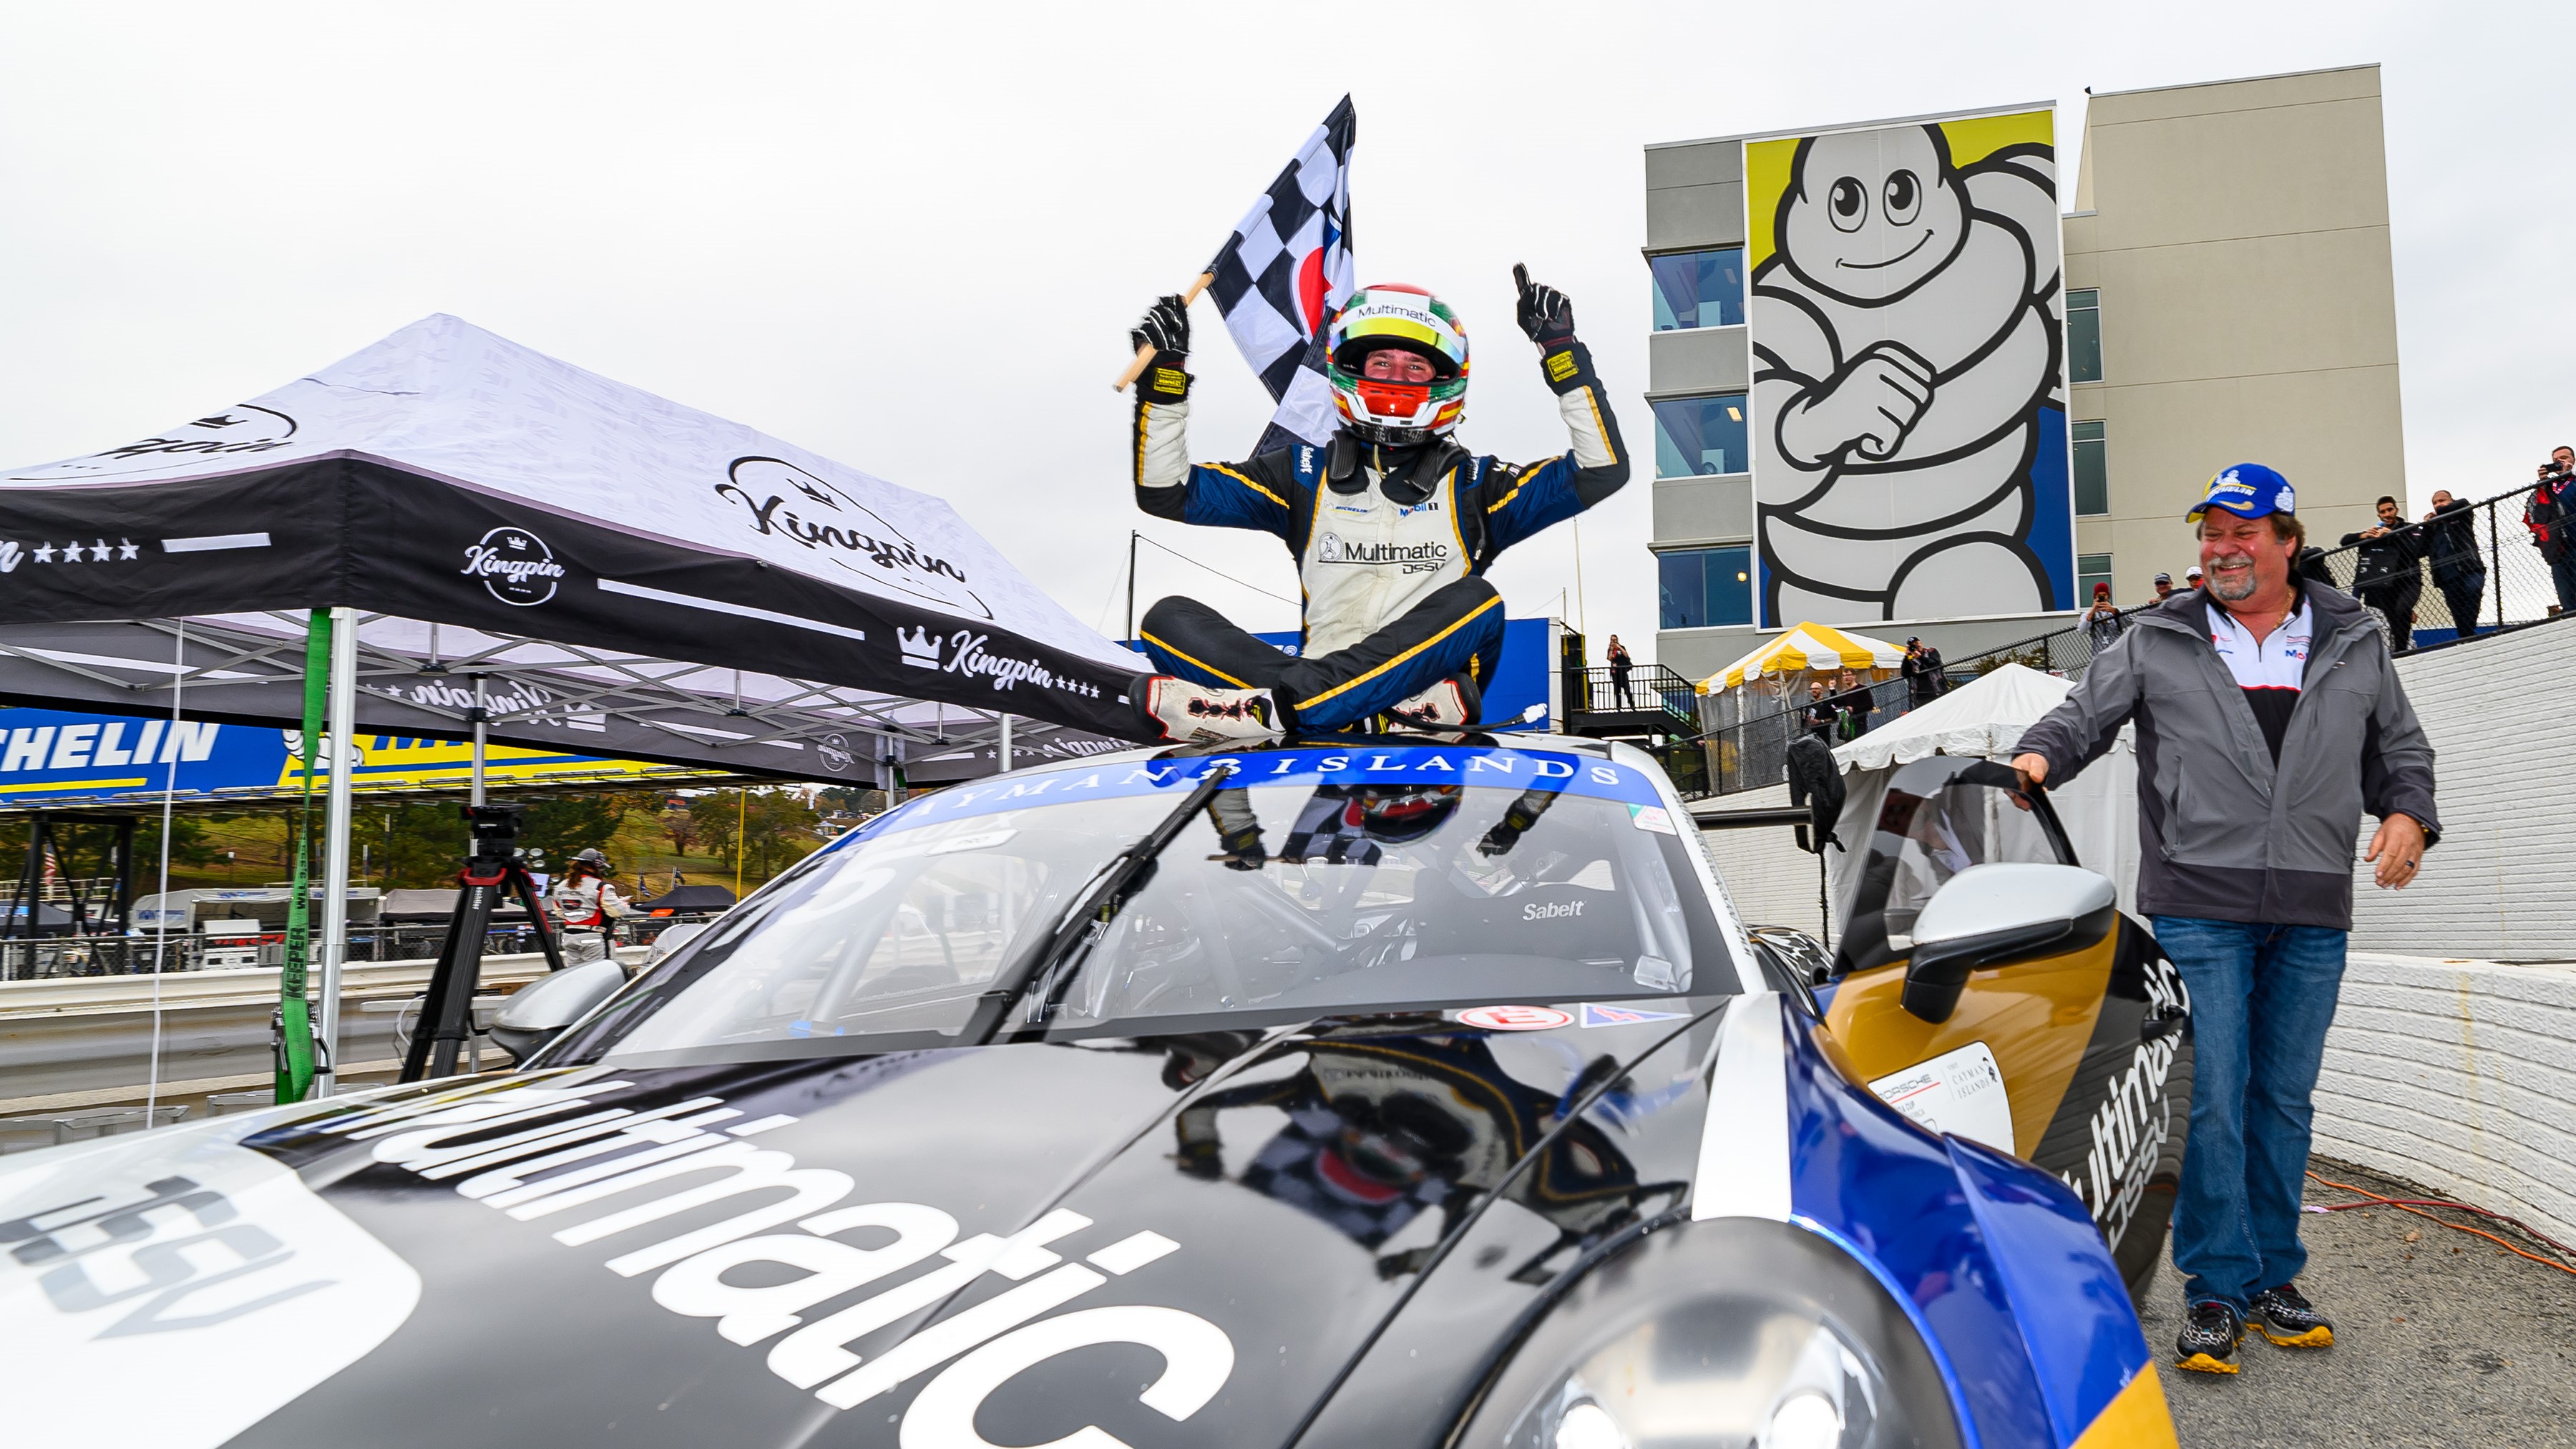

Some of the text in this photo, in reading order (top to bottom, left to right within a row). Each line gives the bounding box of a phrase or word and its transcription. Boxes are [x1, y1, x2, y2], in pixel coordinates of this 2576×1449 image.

[1358, 304, 1437, 327] Multimatic
[1335, 505, 1368, 514] MICHELIN
[1400, 502, 1439, 517] Mobil 1
[714, 483, 966, 583] Kingpin
[460, 545, 565, 583] Kingpin
[1345, 541, 1448, 561] Multimatic
[942, 630, 1053, 691] Kingpin
[1270, 756, 1620, 786] ISLANDS
[1522, 899, 1584, 922] Sabelt
[286, 927, 306, 999] KEEPER
